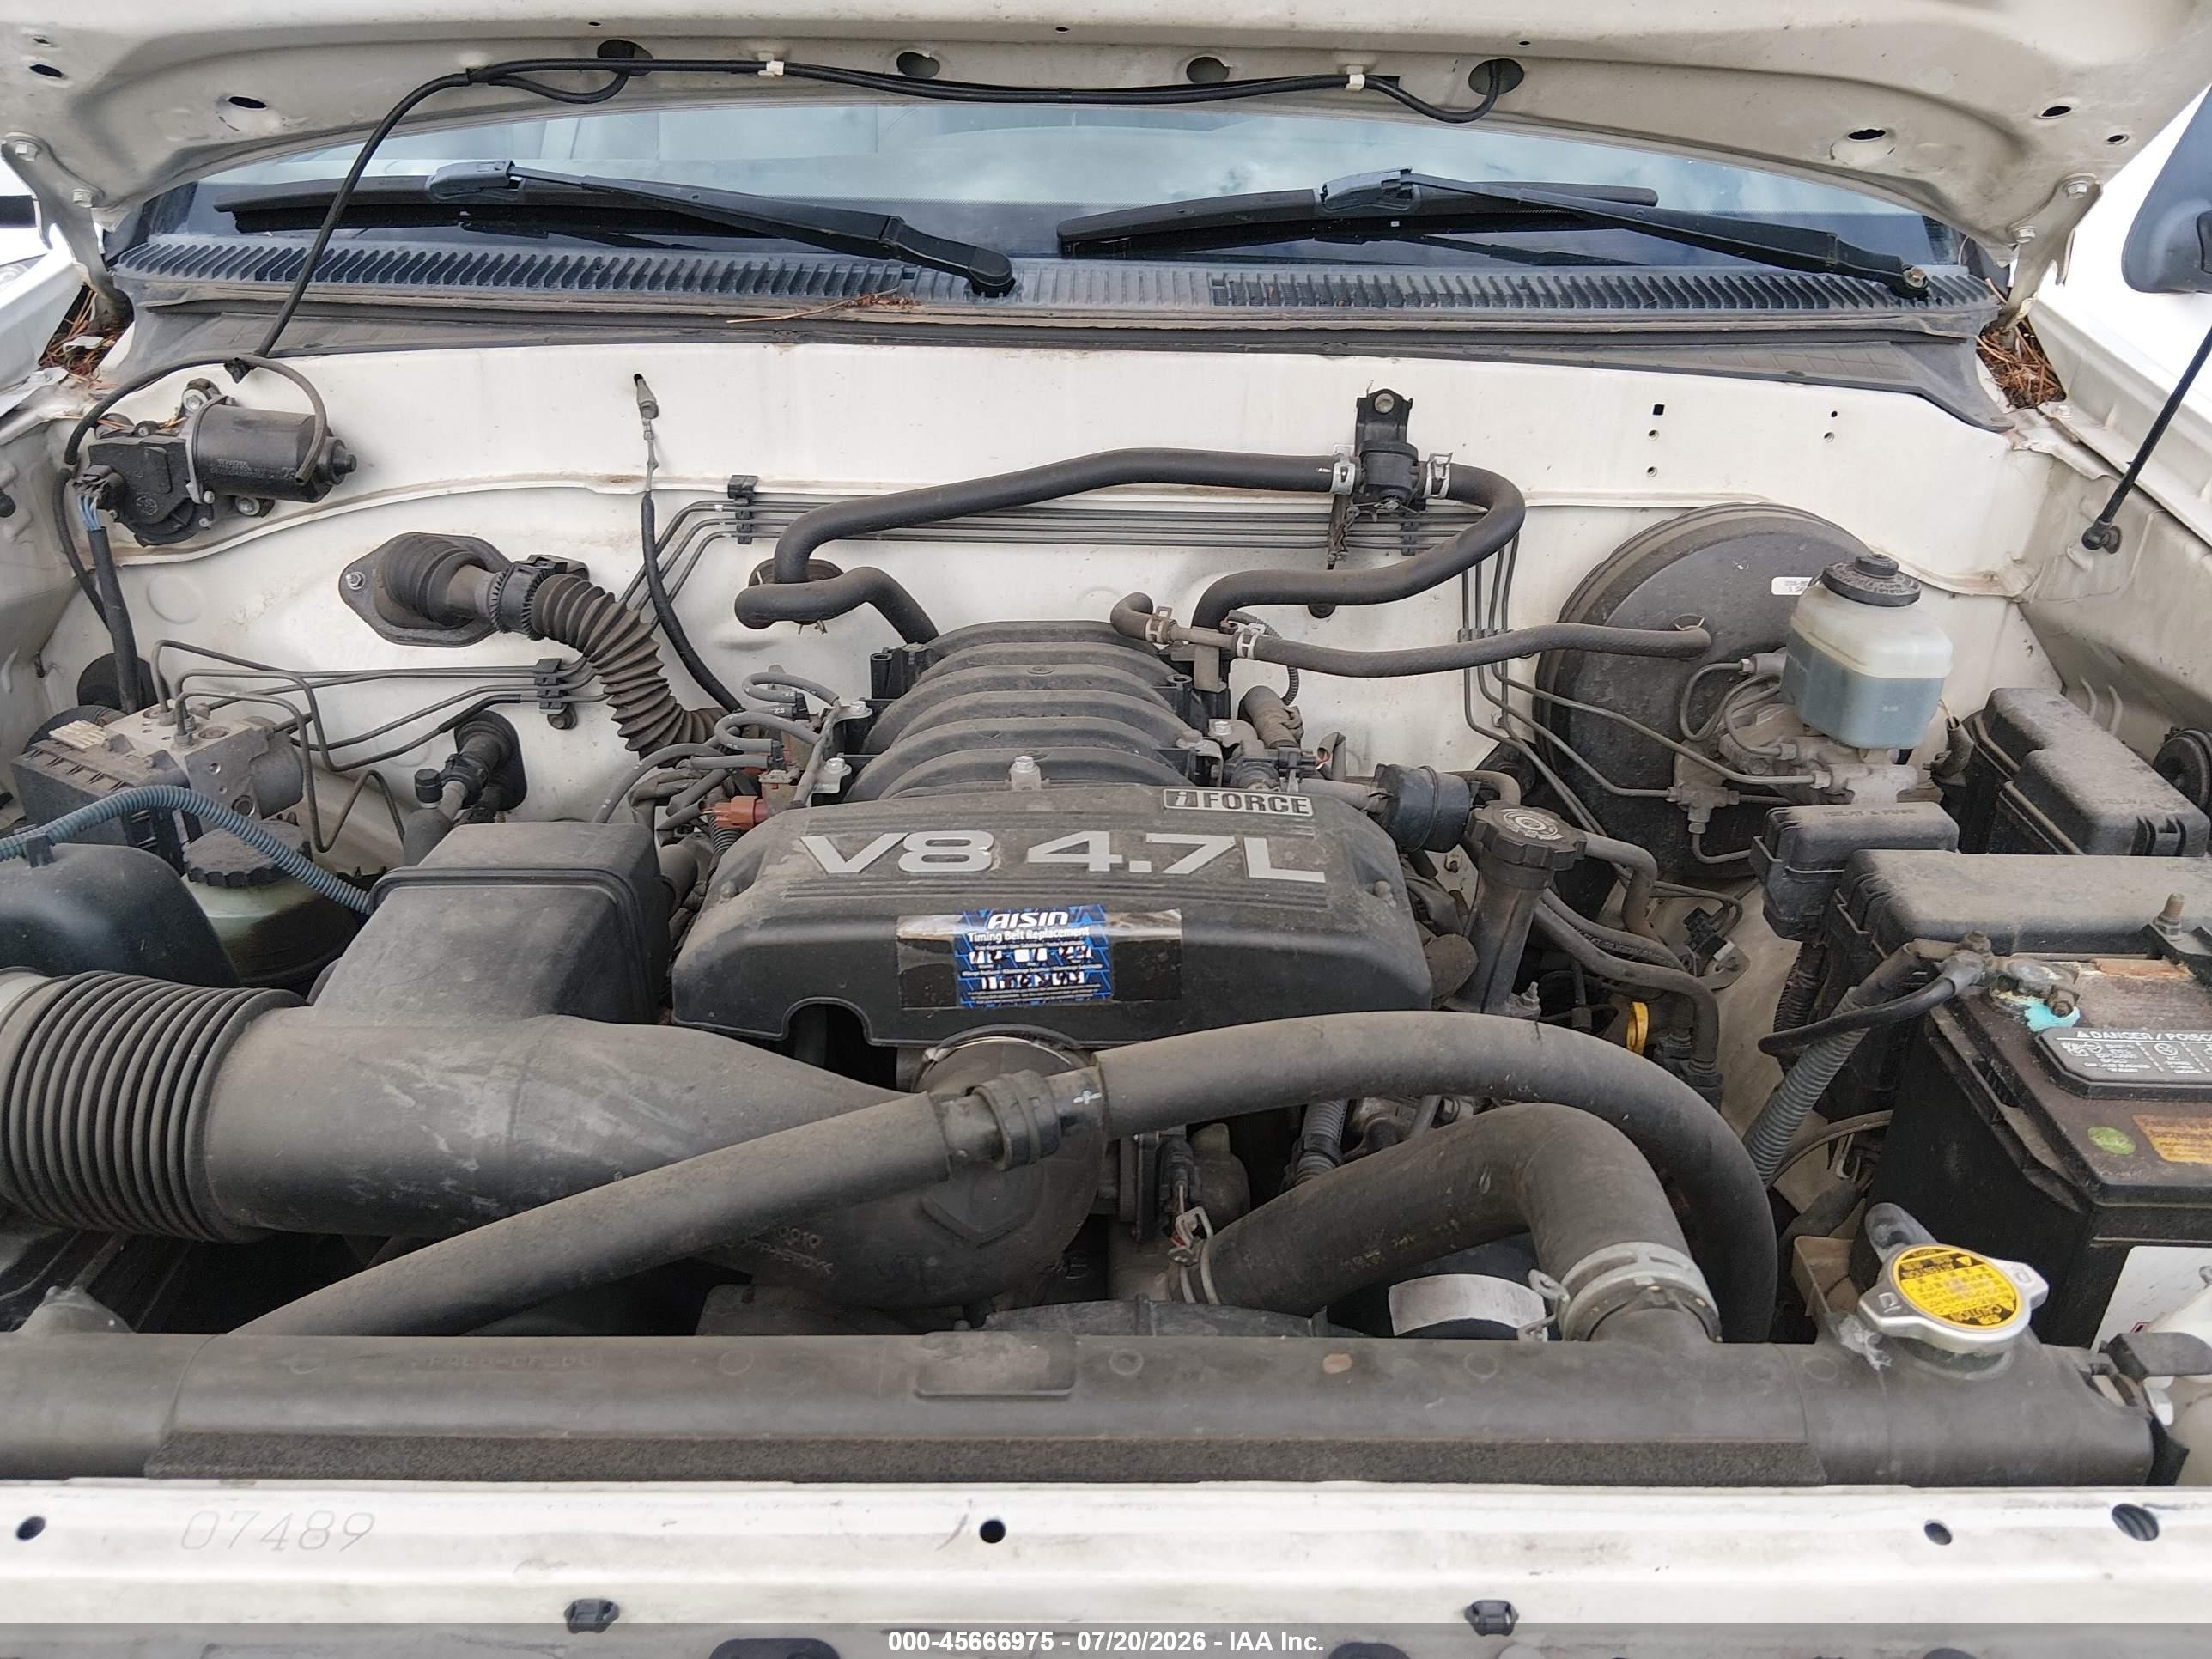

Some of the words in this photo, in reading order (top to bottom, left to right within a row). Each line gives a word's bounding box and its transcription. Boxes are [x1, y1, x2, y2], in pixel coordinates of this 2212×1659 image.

[799, 830, 996, 874] V8
[1026, 830, 1327, 884] 4.7L
[988, 911, 1069, 930] AISIN
[967, 932, 1003, 944] Timing
[1003, 929, 1024, 940] Belt
[1026, 926, 1091, 941] Replacement
[2089, 1031, 2154, 1041] DANGER
[181, 1510, 375, 1553] 07489
